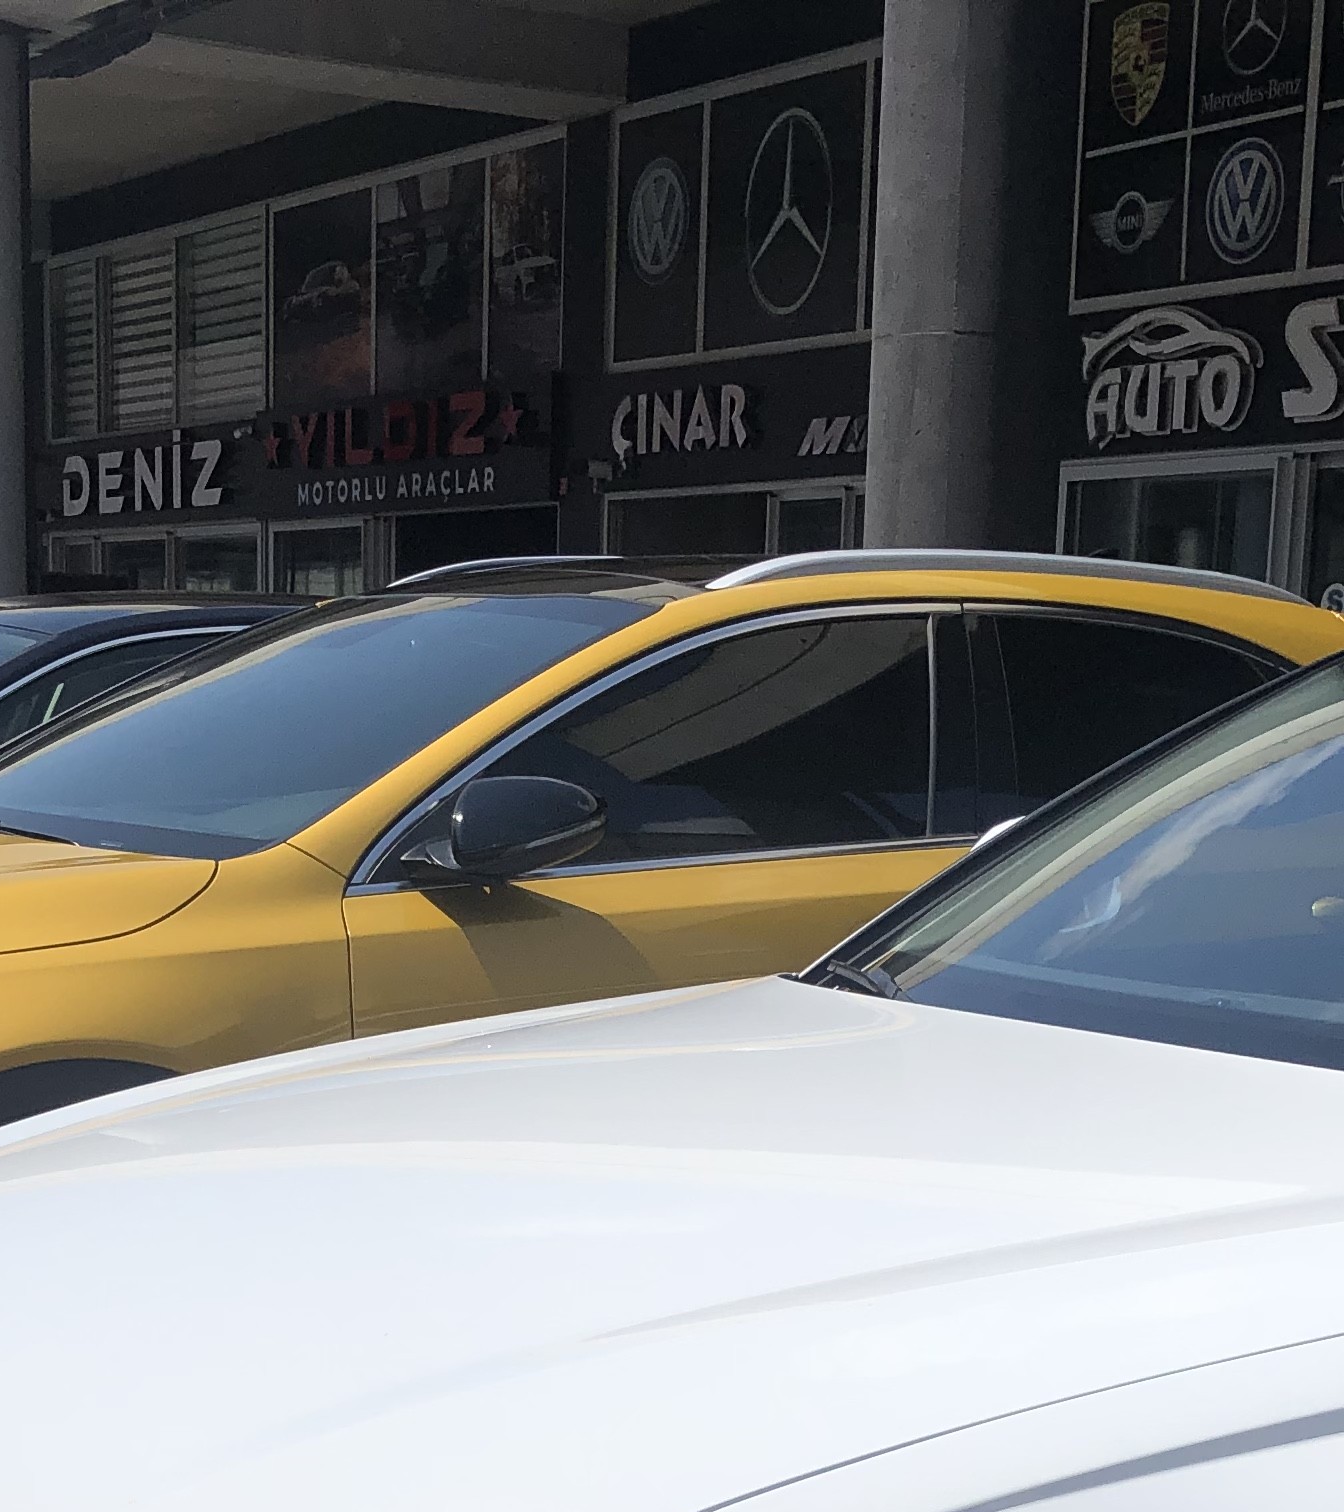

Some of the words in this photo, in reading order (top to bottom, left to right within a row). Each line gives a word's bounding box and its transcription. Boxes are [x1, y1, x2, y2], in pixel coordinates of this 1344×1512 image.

[1200, 78, 1302, 114] Mercedes-Benz
[1117, 213, 1146, 232] MINI
[291, 389, 486, 469] YILDIZ
[612, 383, 747, 471] ÇINAR
[1086, 355, 1254, 450] AUTO
[62, 429, 223, 517] DENİZ
[296, 475, 387, 507] MOTORLU
[396, 466, 496, 503] ARAÇLAR
